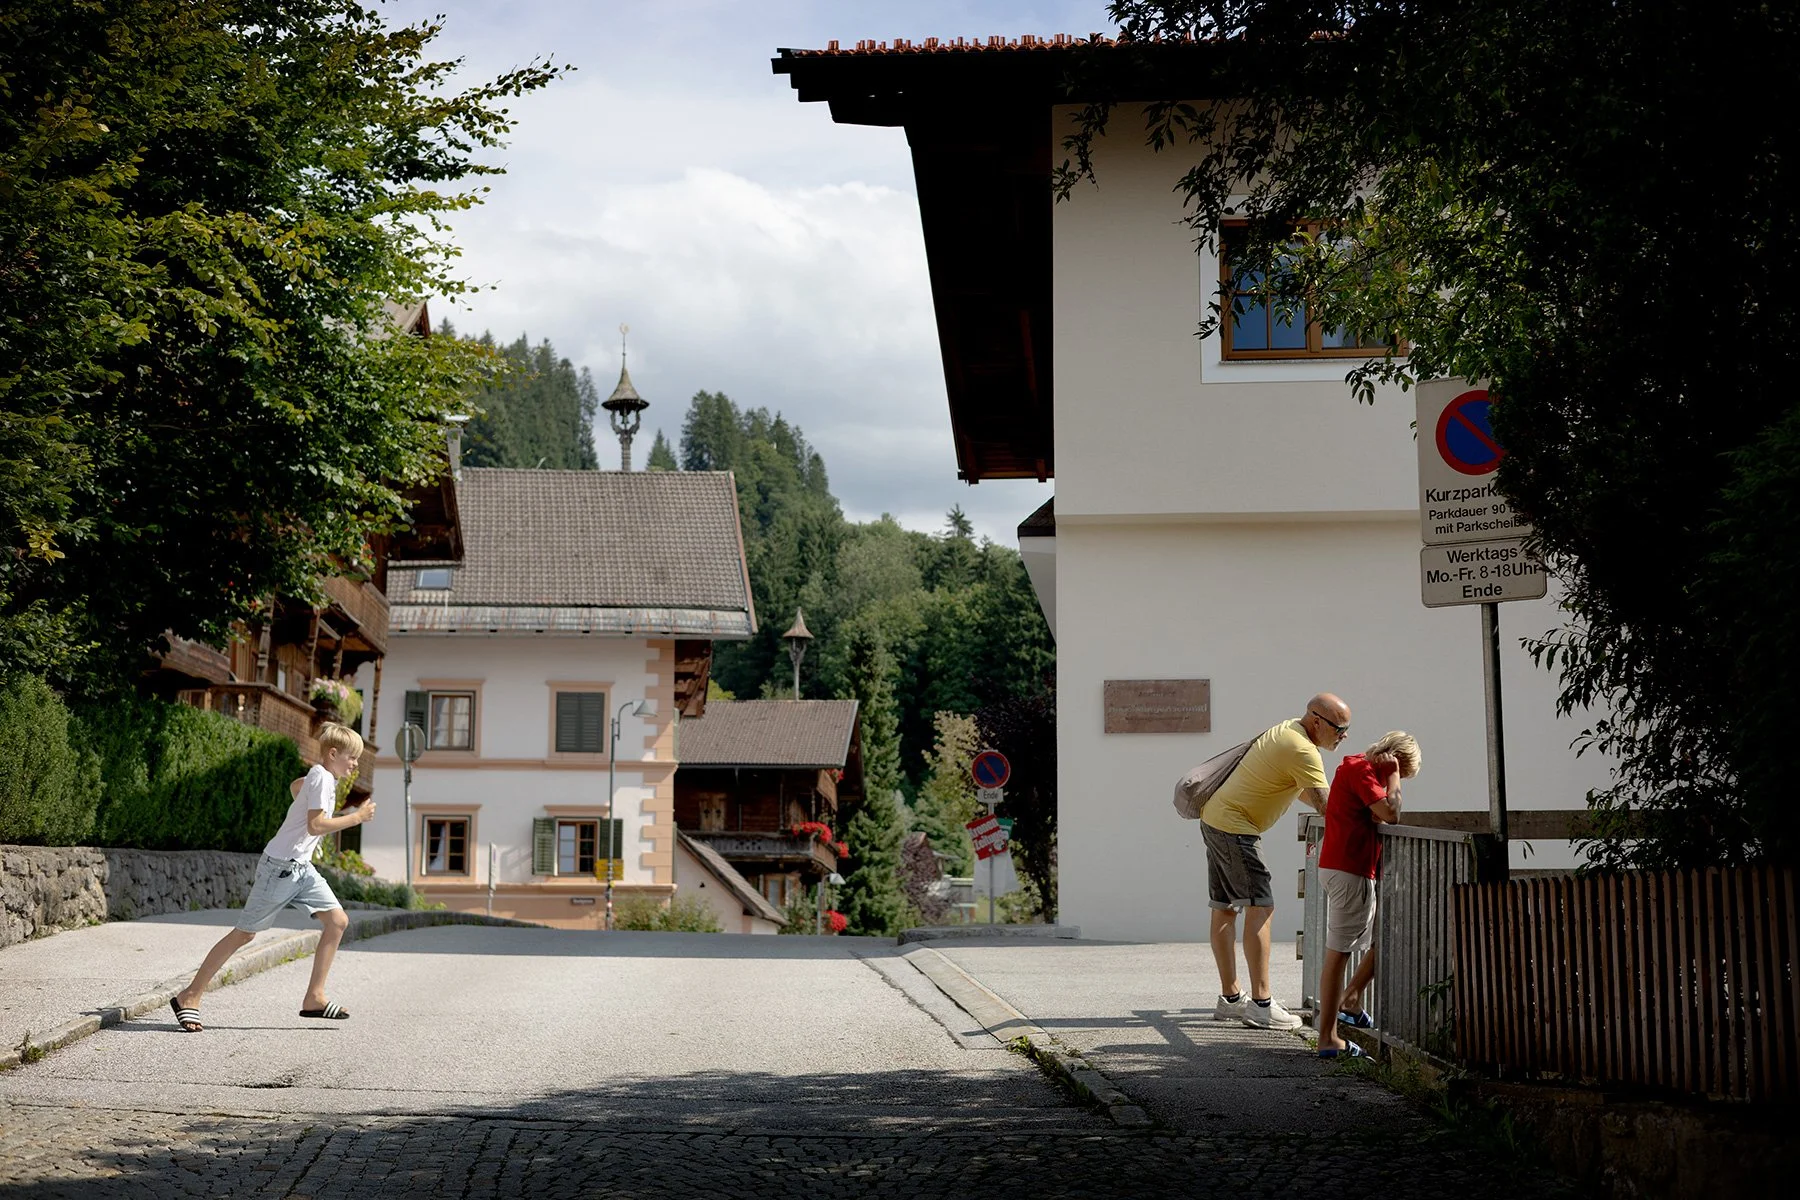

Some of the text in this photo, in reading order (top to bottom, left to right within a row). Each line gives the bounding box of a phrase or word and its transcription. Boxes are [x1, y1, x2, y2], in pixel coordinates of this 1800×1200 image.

[1425, 483, 1500, 503] Kurzpark
[1428, 506, 1488, 520] Parkdauer
[1491, 503, 1506, 514] 90
[1435, 522, 1454, 535] mit
[1447, 547, 1518, 564] Werktags
[1426, 567, 1476, 583] Mo.-Fr.
[1462, 583, 1503, 598] Ende
[983, 790, 998, 799] Ende
